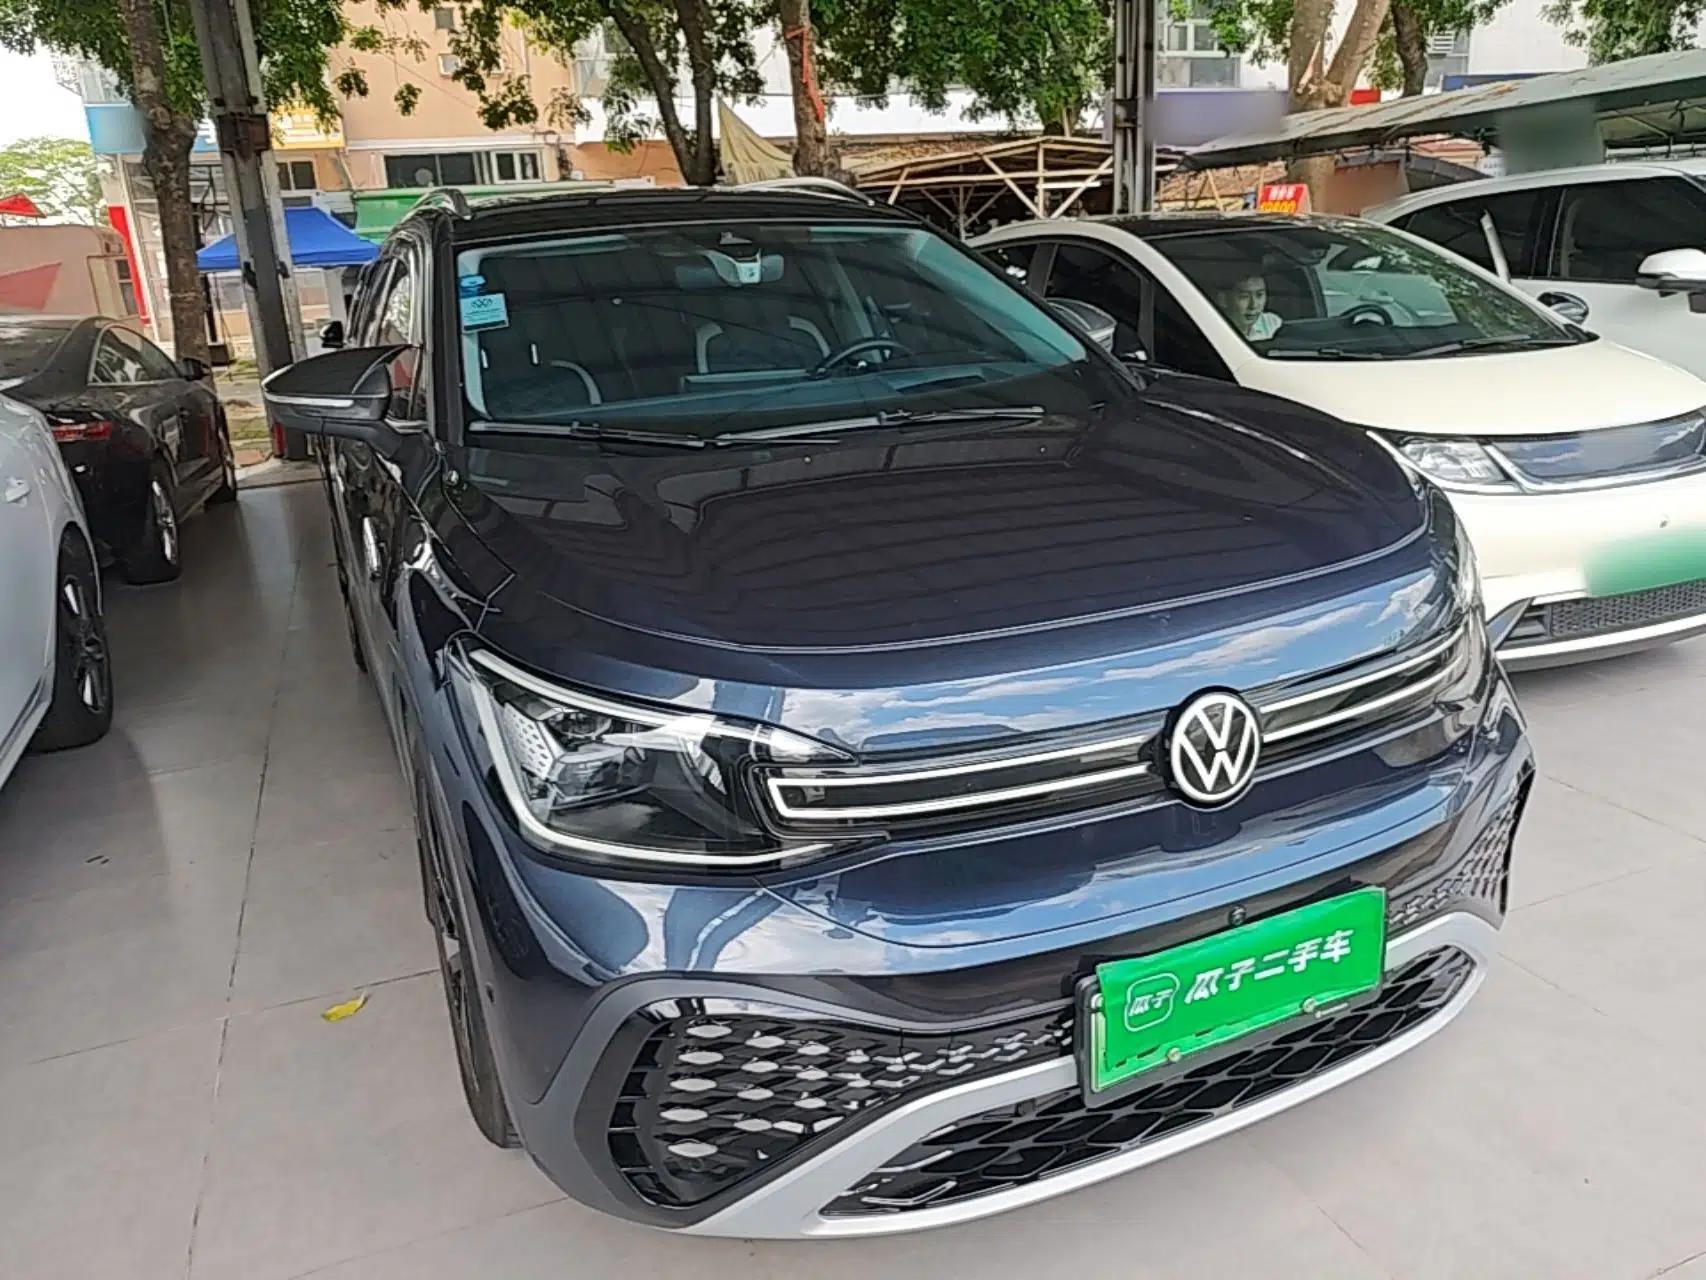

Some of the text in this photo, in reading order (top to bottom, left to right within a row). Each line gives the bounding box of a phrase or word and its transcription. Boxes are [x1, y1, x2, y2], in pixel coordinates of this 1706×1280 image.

[1175, 695, 1257, 799] VW
[1128, 988, 1174, 1017] 瓜子
[1184, 929, 1354, 1004] 瓜子二手车
